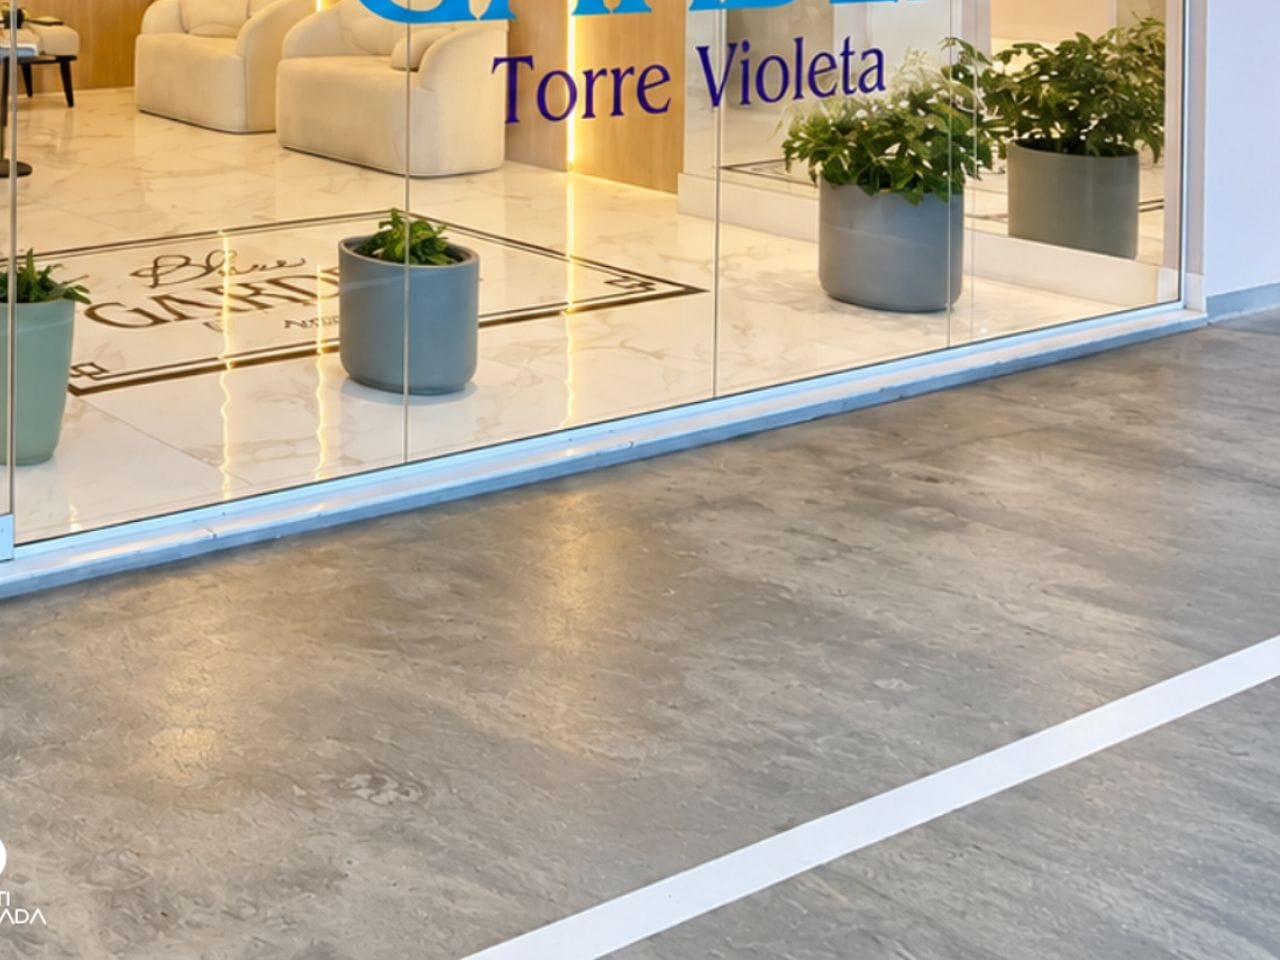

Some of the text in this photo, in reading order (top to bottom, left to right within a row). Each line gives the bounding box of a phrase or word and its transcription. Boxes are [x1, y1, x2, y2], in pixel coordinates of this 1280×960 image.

[492, 36, 887, 124] Torre Violeta
[83, 266, 339, 329] GARD
